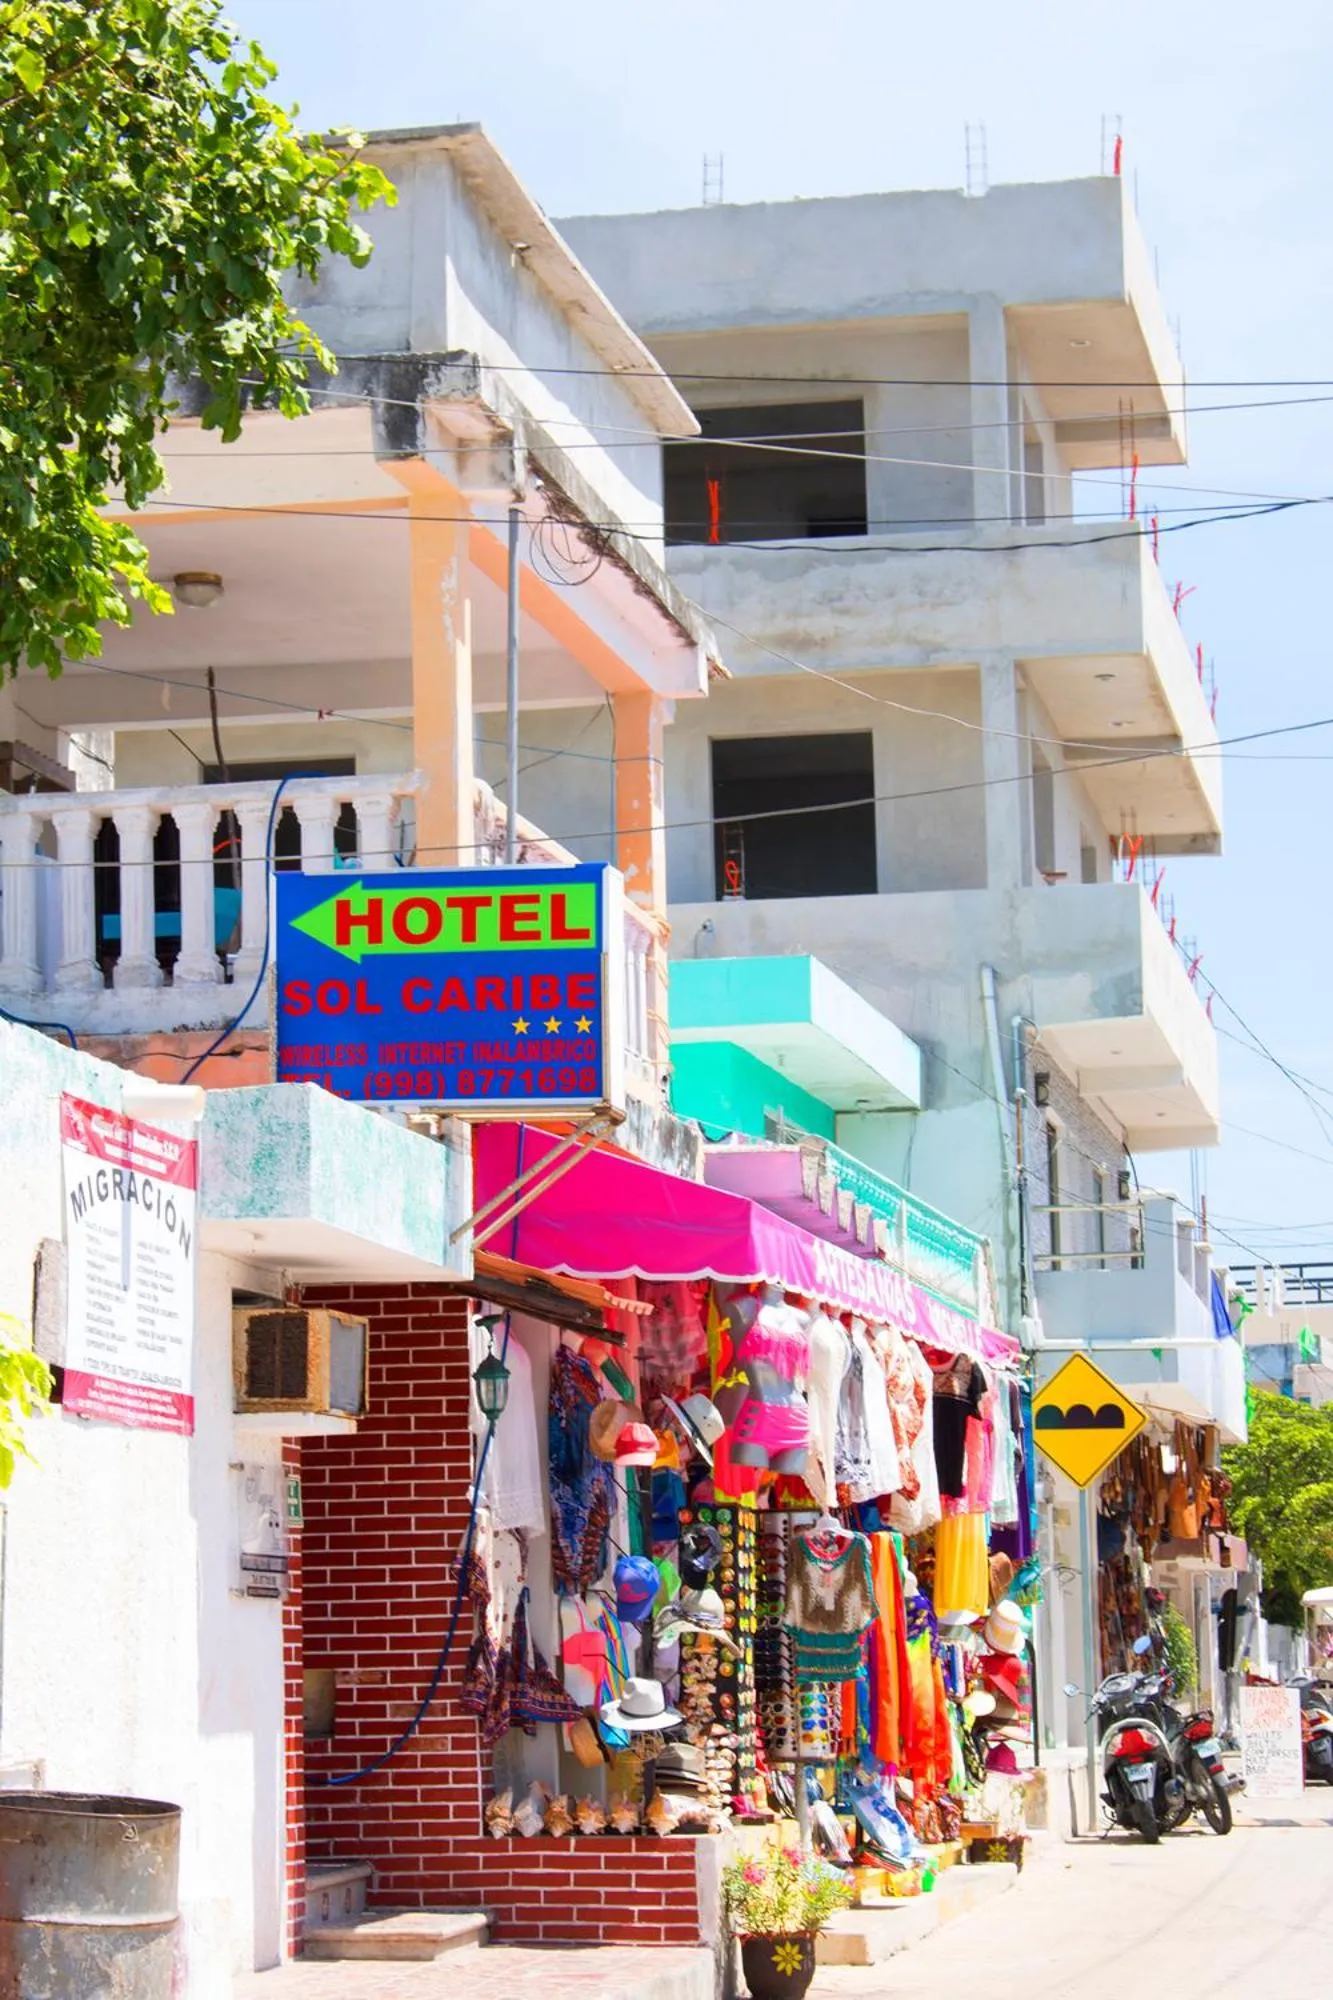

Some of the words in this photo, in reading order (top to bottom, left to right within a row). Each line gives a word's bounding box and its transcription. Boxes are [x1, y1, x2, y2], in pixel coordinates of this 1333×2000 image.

[334, 893, 591, 946] HOTEL
[283, 979, 383, 1016] SOL
[401, 973, 597, 1014] CARIBE
[280, 1043, 368, 1068] WIRELESS
[378, 1041, 466, 1065] INTERNET
[363, 1070, 446, 1101] (998)
[457, 1066, 597, 1095] 8771698
[70, 1167, 192, 1259] MIGRACIÓN
